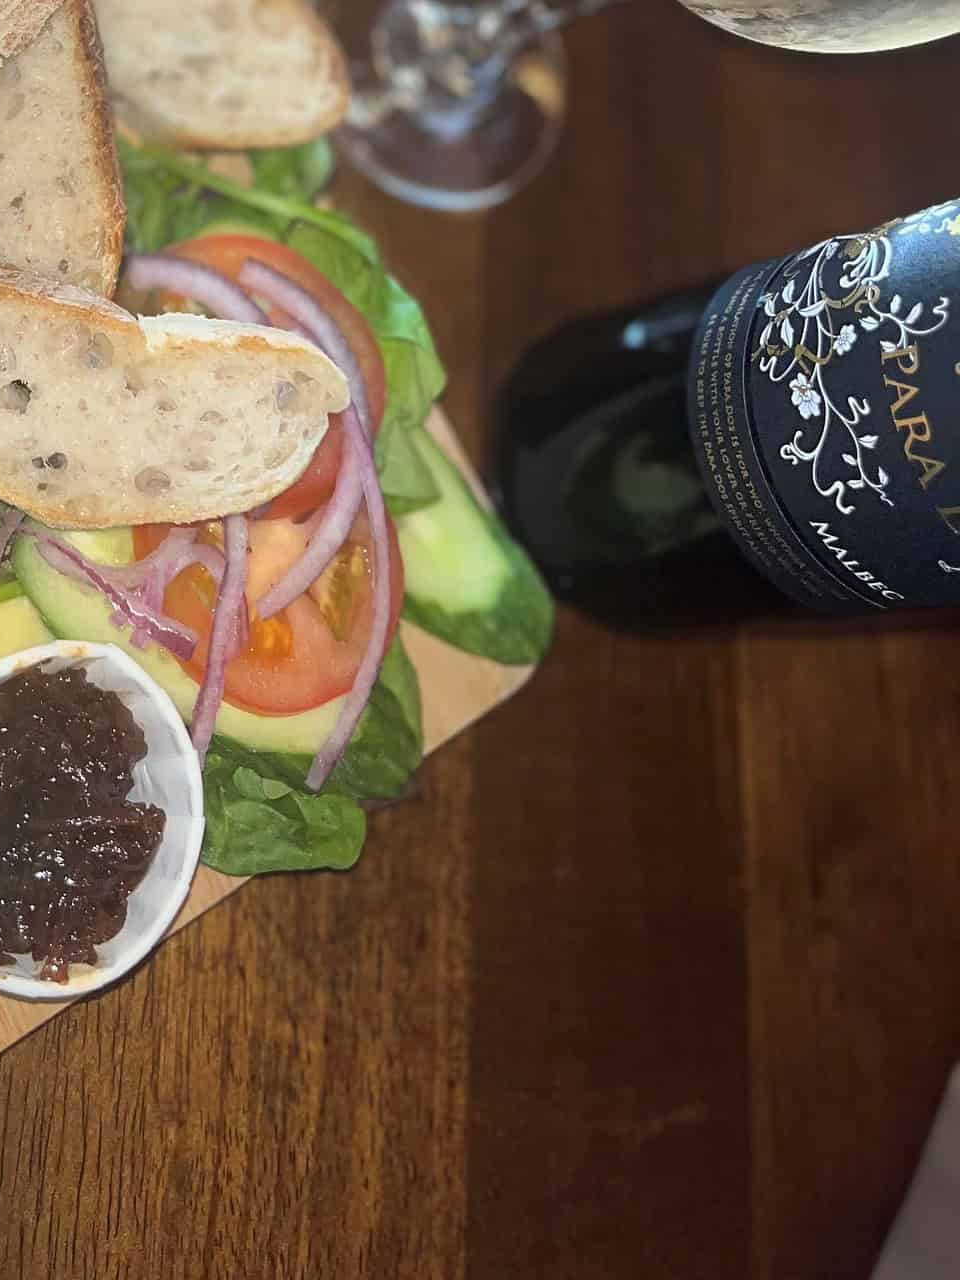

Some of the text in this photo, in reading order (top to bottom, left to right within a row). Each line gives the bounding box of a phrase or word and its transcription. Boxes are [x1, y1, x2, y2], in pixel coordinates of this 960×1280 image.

[697, 358, 706, 376] TO
[711, 370, 719, 405] WITH
[697, 413, 709, 438] THE
[711, 408, 725, 444] YOUR
[725, 405, 736, 432] DOS
[881, 340, 946, 492] PARA
[704, 441, 716, 472] PARA
[730, 435, 740, 448] IS
[720, 448, 738, 488] LOVER
[714, 474, 729, 500] DOS
[808, 520, 905, 600] MALBEC
